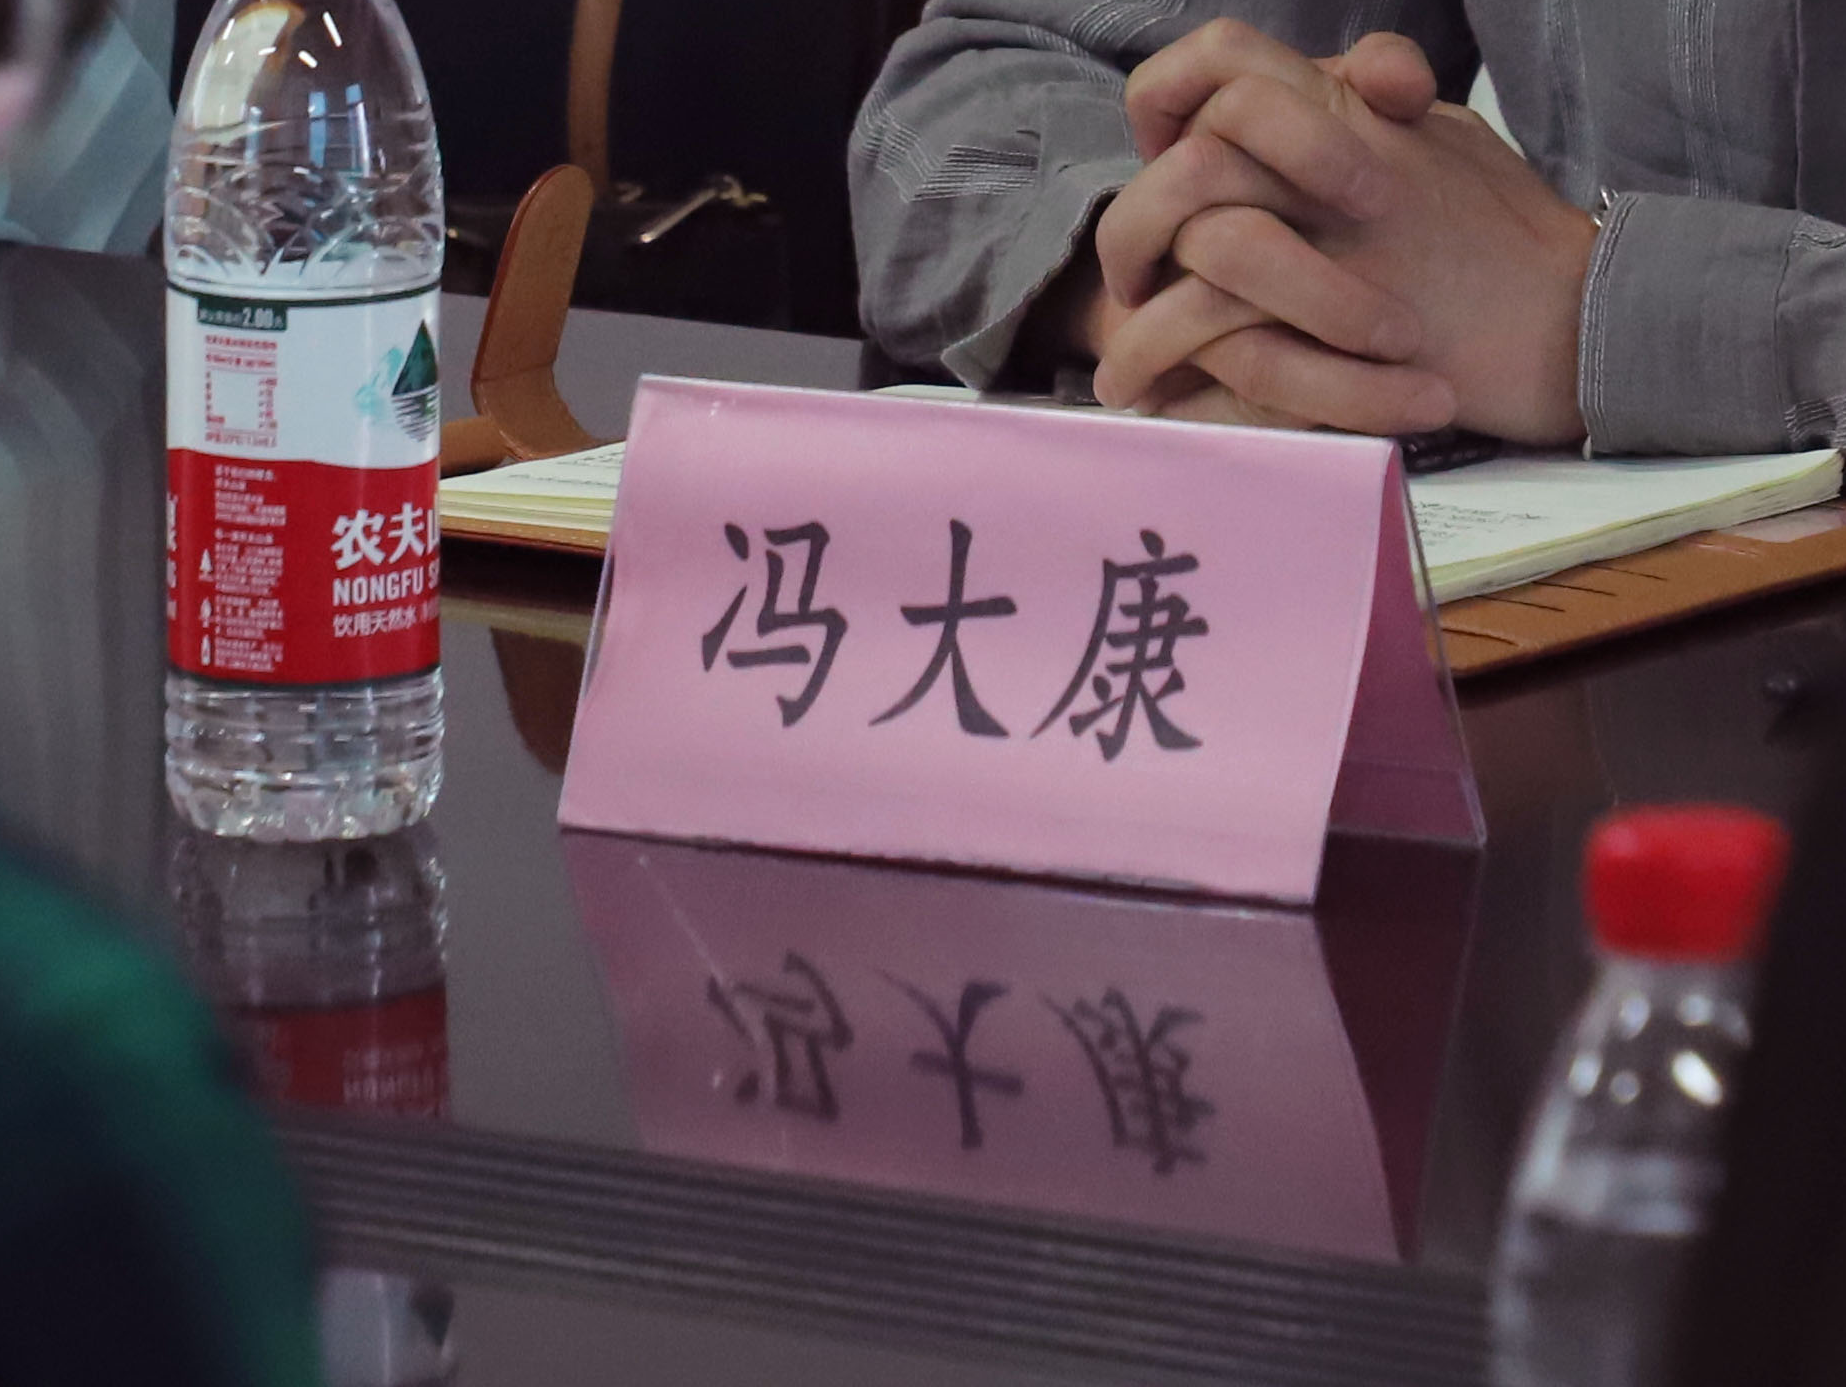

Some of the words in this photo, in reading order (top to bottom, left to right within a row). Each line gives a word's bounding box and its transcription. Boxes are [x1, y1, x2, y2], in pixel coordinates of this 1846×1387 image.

[332, 565, 425, 607] NONGFU
[700, 519, 1210, 763] 冯大康
